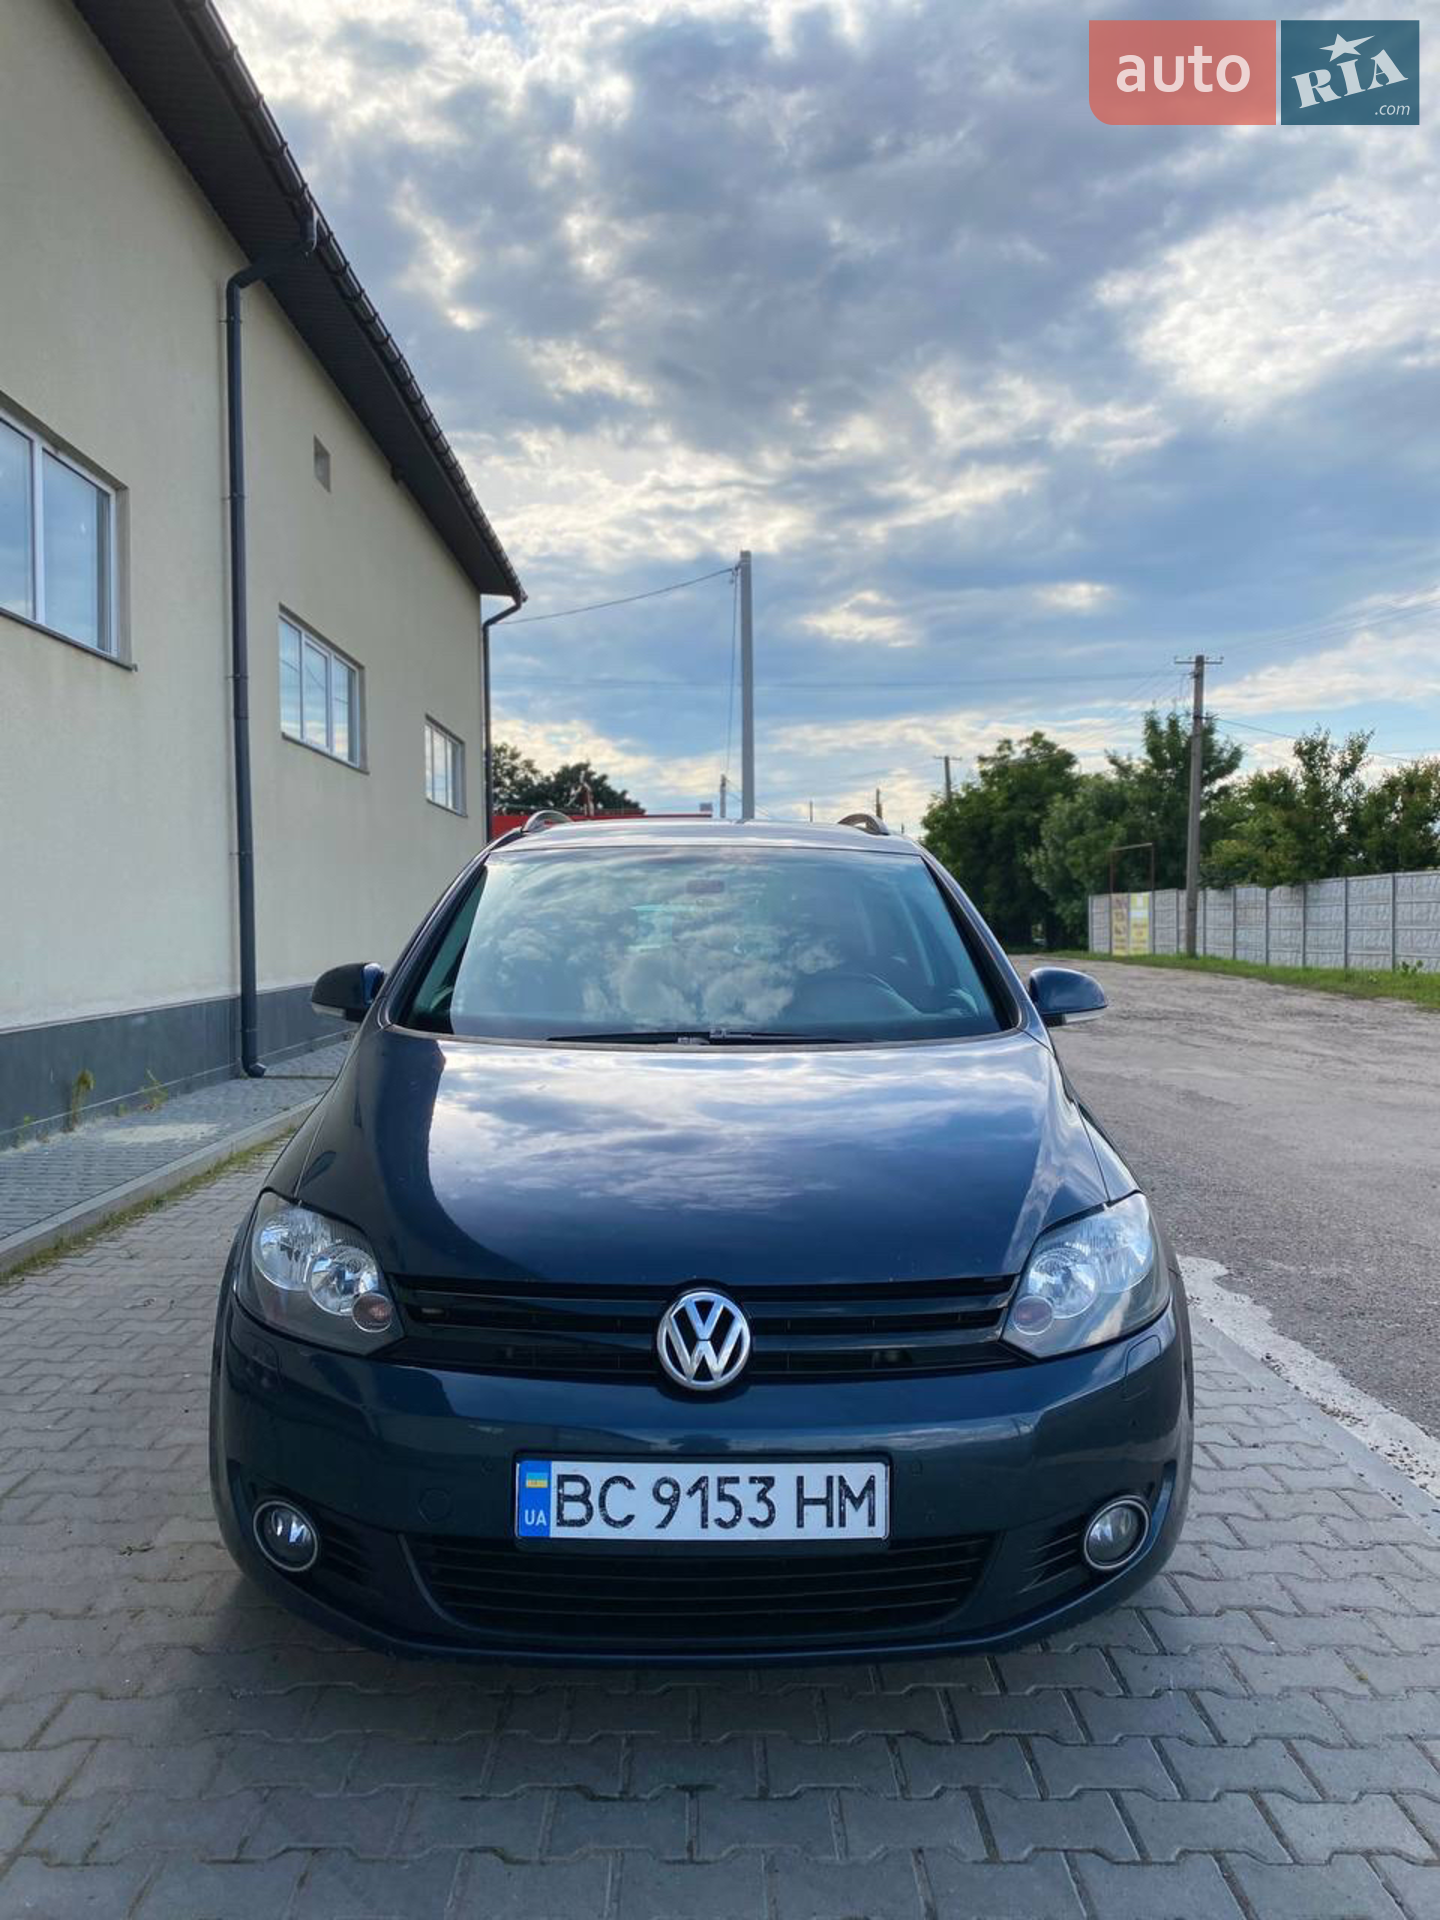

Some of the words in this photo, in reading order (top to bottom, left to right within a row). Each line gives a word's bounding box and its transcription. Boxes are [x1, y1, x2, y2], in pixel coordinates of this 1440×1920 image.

[660, 1294, 746, 1386] VW
[524, 1510, 548, 1526] UA
[556, 1474, 636, 1529] BC
[652, 1475, 776, 1529] 9153
[796, 1475, 876, 1528] HM
